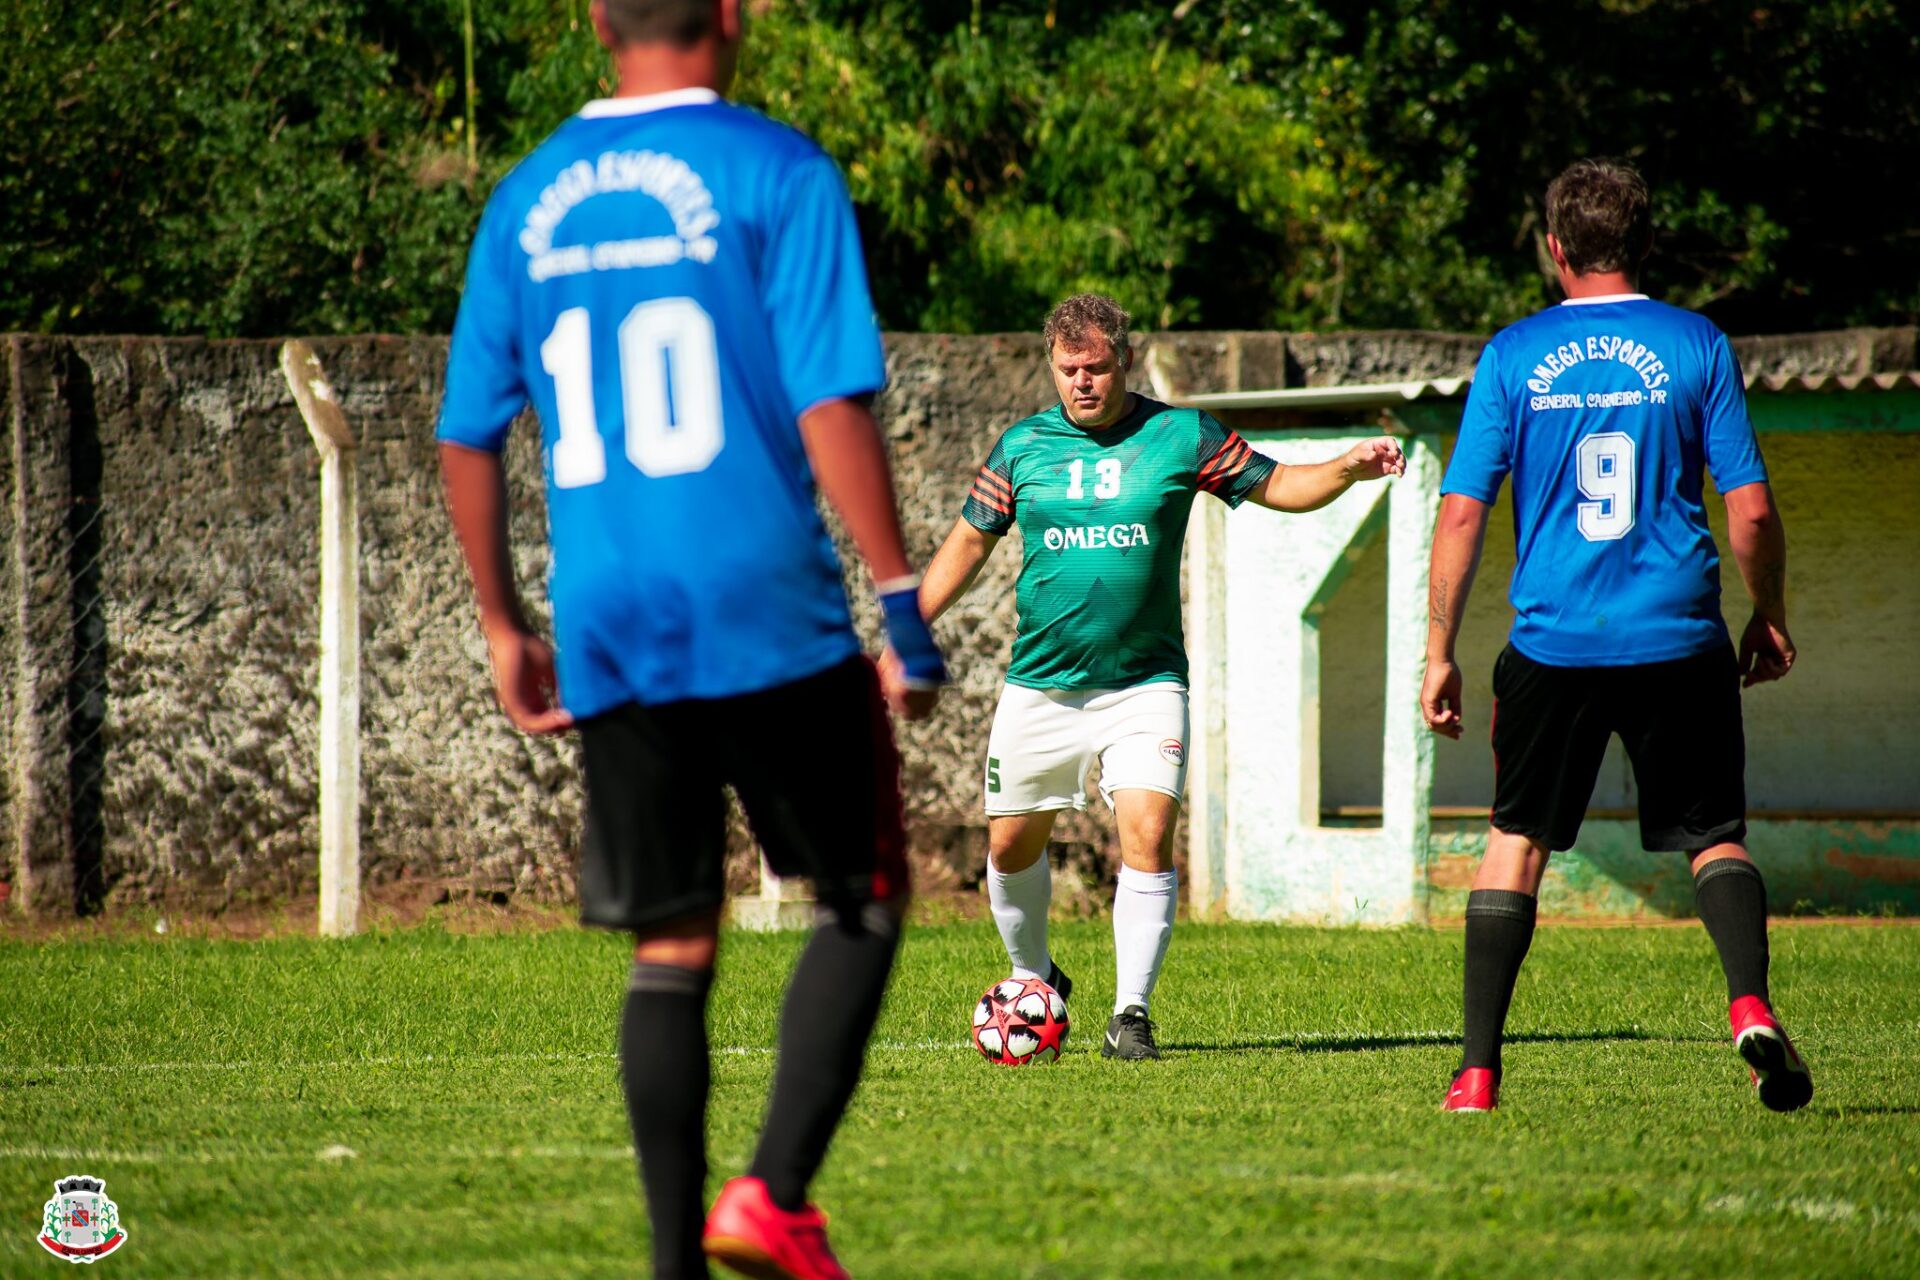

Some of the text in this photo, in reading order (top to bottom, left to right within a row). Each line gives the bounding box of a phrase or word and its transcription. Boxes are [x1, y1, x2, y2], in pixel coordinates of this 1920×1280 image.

[1527, 335, 1670, 394] OMEGA ESPORTES
[540, 296, 725, 489] 10
[1530, 394, 1583, 411] GENERAL
[1586, 390, 1641, 408] CARNEIRO
[1650, 390, 1667, 404] PR
[1066, 457, 1122, 500] 13
[1576, 431, 1636, 542] 9
[1043, 523, 1150, 550] OMEGA
